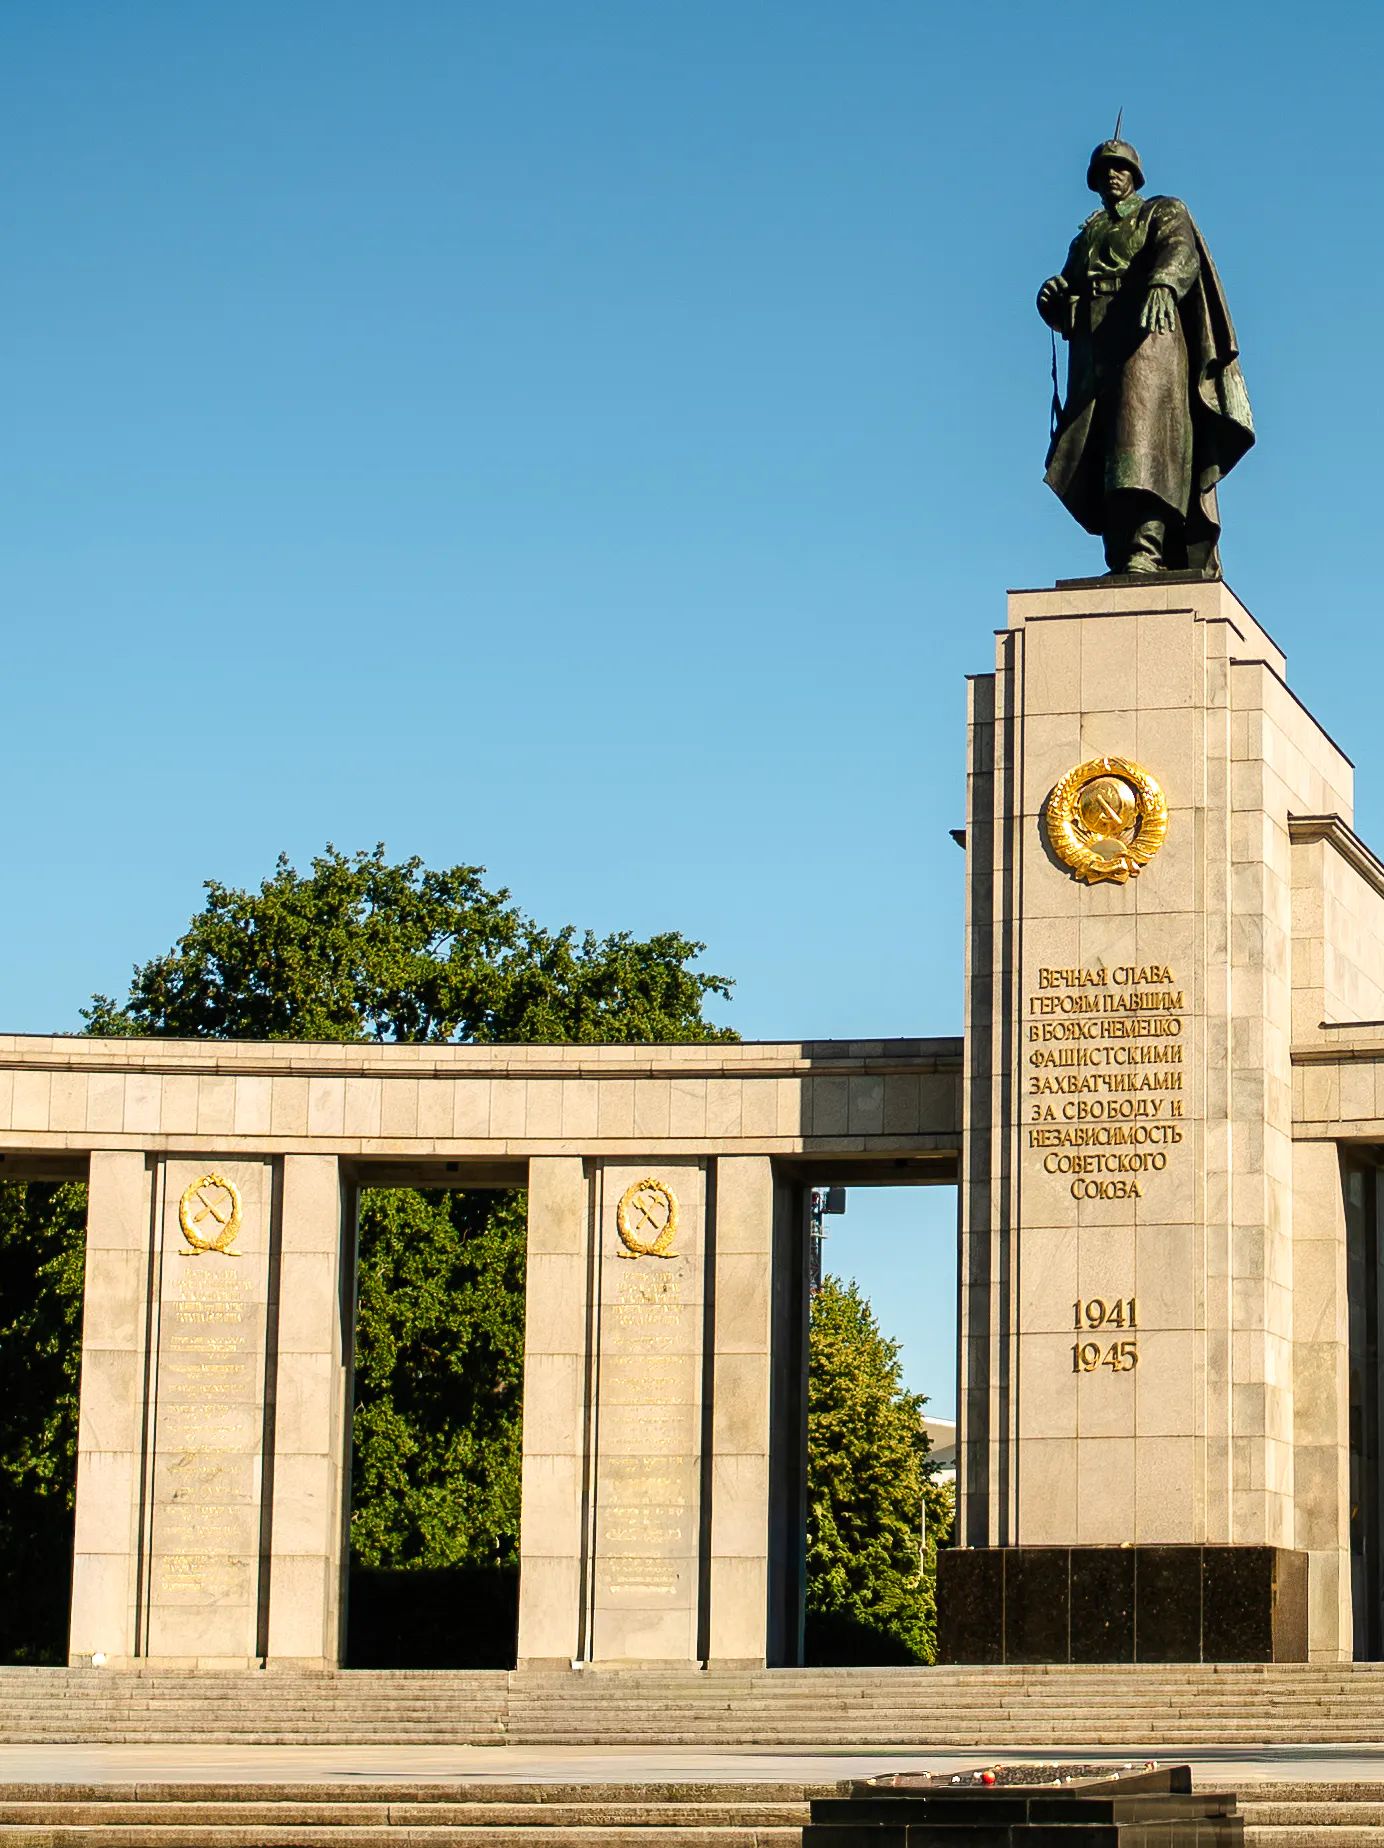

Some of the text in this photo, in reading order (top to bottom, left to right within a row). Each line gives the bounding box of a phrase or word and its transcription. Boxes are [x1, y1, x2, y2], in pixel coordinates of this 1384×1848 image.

[1039, 965, 1174, 989] ВЕЧНАЯ СЛАВА
[1030, 991, 1183, 1014] ГЕРОЯМ ПАВШИМ
[1030, 1025, 1040, 1042] В
[1042, 1021, 1087, 1041] БОЯХ
[1100, 1018, 1183, 1038] НЕМЕЦКО
[1029, 1045, 1183, 1068] ФАШИСТСКИМИ
[1029, 1072, 1183, 1094] ЗАХВАТЧИКАМИ
[1032, 1099, 1183, 1121] ЗА СВОБОДУ И
[1029, 1125, 1183, 1148] НЕЗАВИСИМОСТЬ
[1044, 1152, 1167, 1174] СОВЕТСКОГО
[1070, 1178, 1142, 1200] СОЮЗА
[1072, 1297, 1137, 1330] 1941
[1070, 1340, 1139, 1373] 1945
